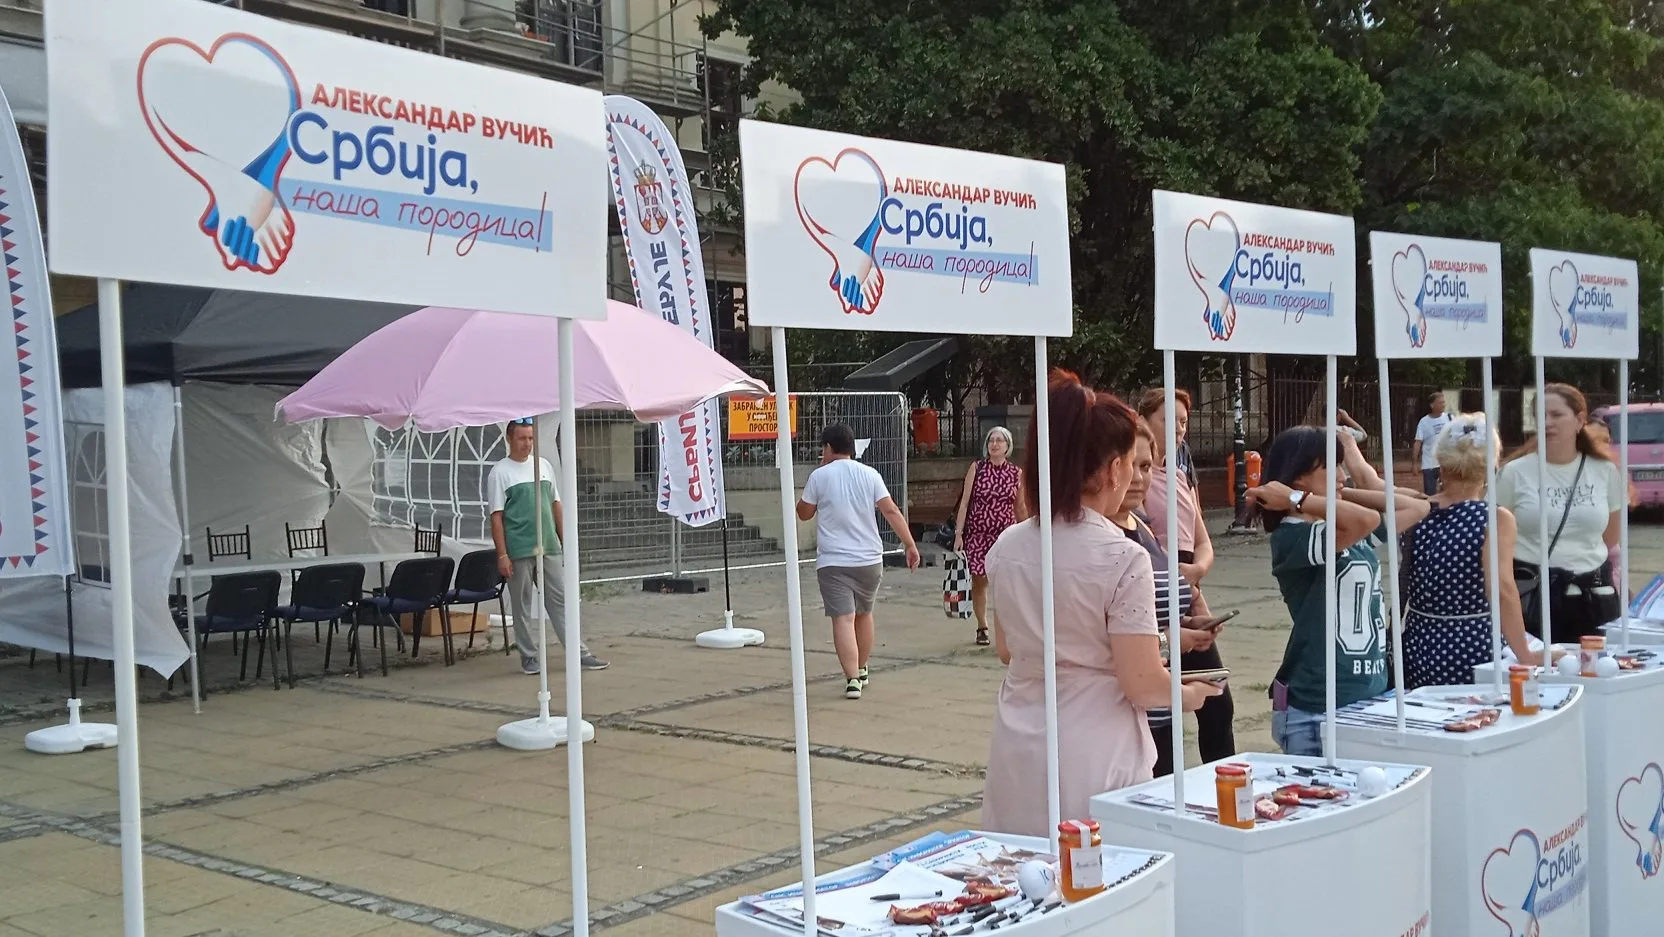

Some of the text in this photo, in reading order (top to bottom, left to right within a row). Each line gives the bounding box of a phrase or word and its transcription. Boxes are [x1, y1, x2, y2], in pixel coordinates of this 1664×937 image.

[312, 83, 554, 149] АЛЕКСАНДАР ВУЧИЋ
[289, 110, 479, 196] Србија,
[893, 176, 1036, 210] АЛЕКСАНДАР ВУЧИЋ
[292, 186, 548, 256] наша породица!
[880, 197, 993, 250] Србија,
[1243, 233, 1335, 256] АЛЕКСАНДАР ВУЧИЋ
[1428, 260, 1468, 273] АЛЕКСАНДАР
[882, 241, 1034, 295] наша породица!
[1235, 249, 1305, 290] Србија,
[1424, 274, 1469, 303] Србија,
[1234, 281, 1332, 325] наша породица!
